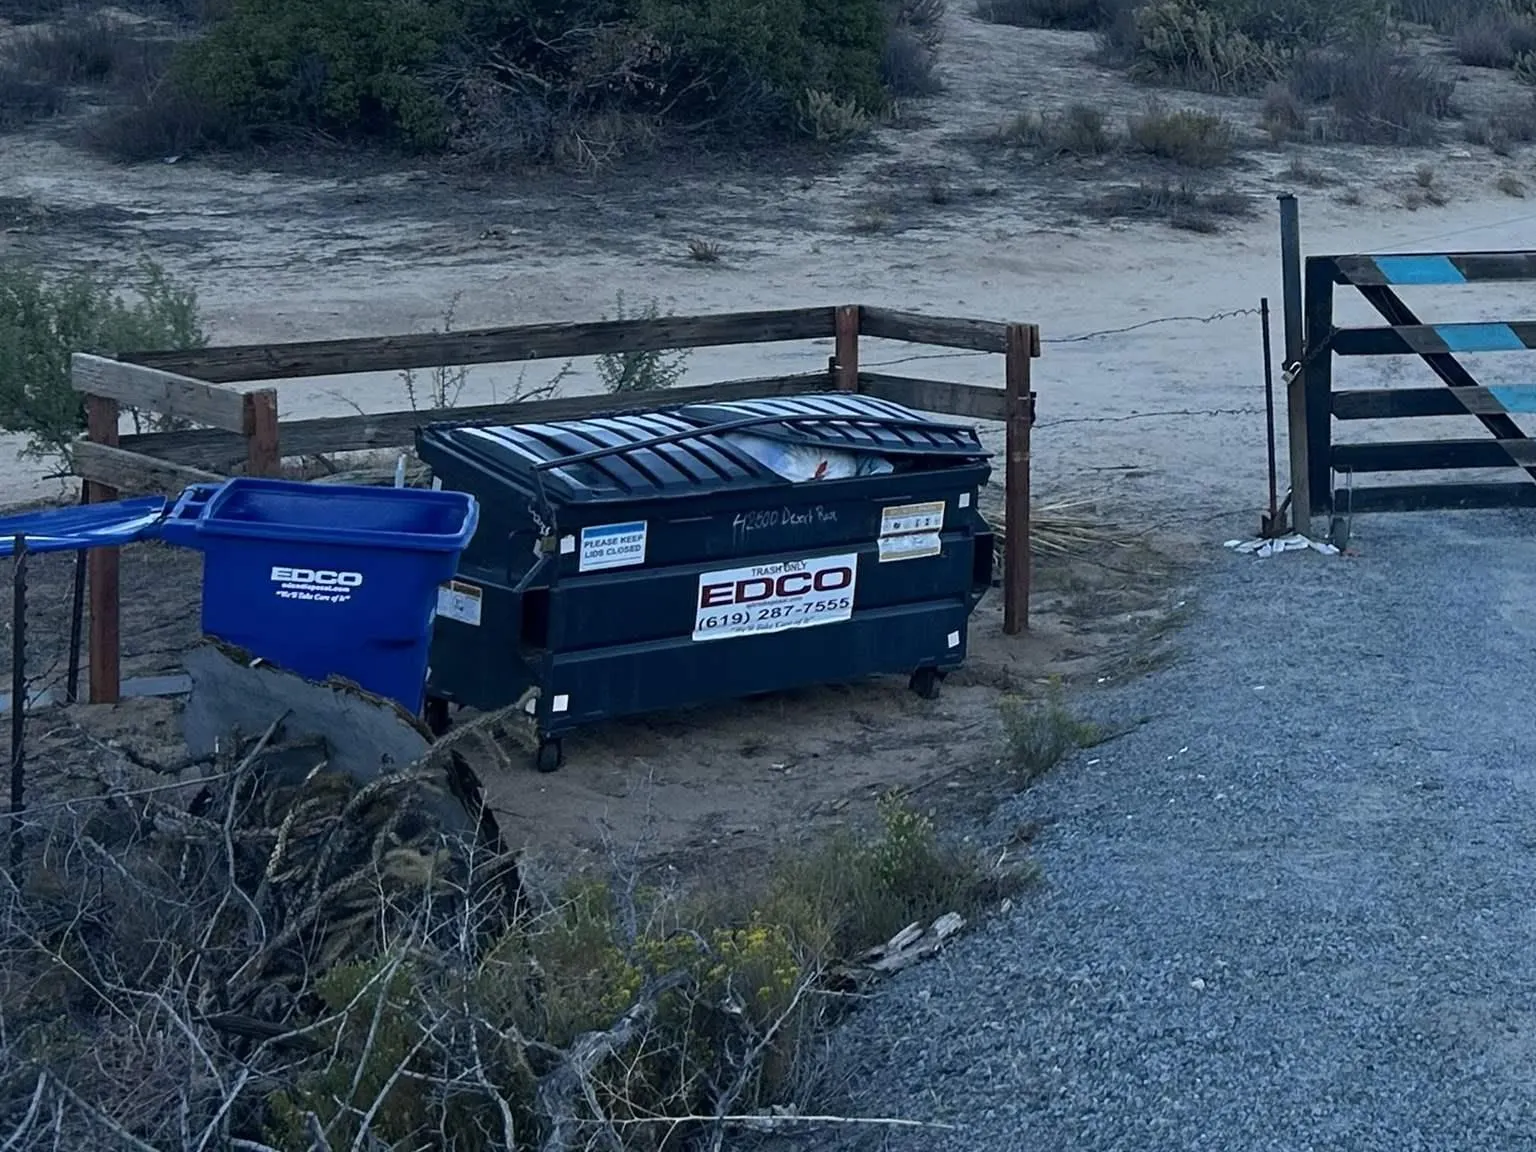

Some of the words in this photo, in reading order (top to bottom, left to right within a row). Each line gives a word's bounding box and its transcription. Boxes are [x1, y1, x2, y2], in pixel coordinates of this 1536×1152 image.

[584, 537, 618, 548] PLEASE
[620, 534, 643, 544] KEEP
[585, 548, 604, 559] LIDS
[606, 544, 641, 556] CLOSED
[271, 566, 363, 586] EDCO
[751, 565, 782, 577] TRASH
[783, 560, 808, 572] ONLY
[700, 566, 852, 609] EDCO
[699, 611, 750, 631] (619)
[758, 597, 850, 621] 287-7555
